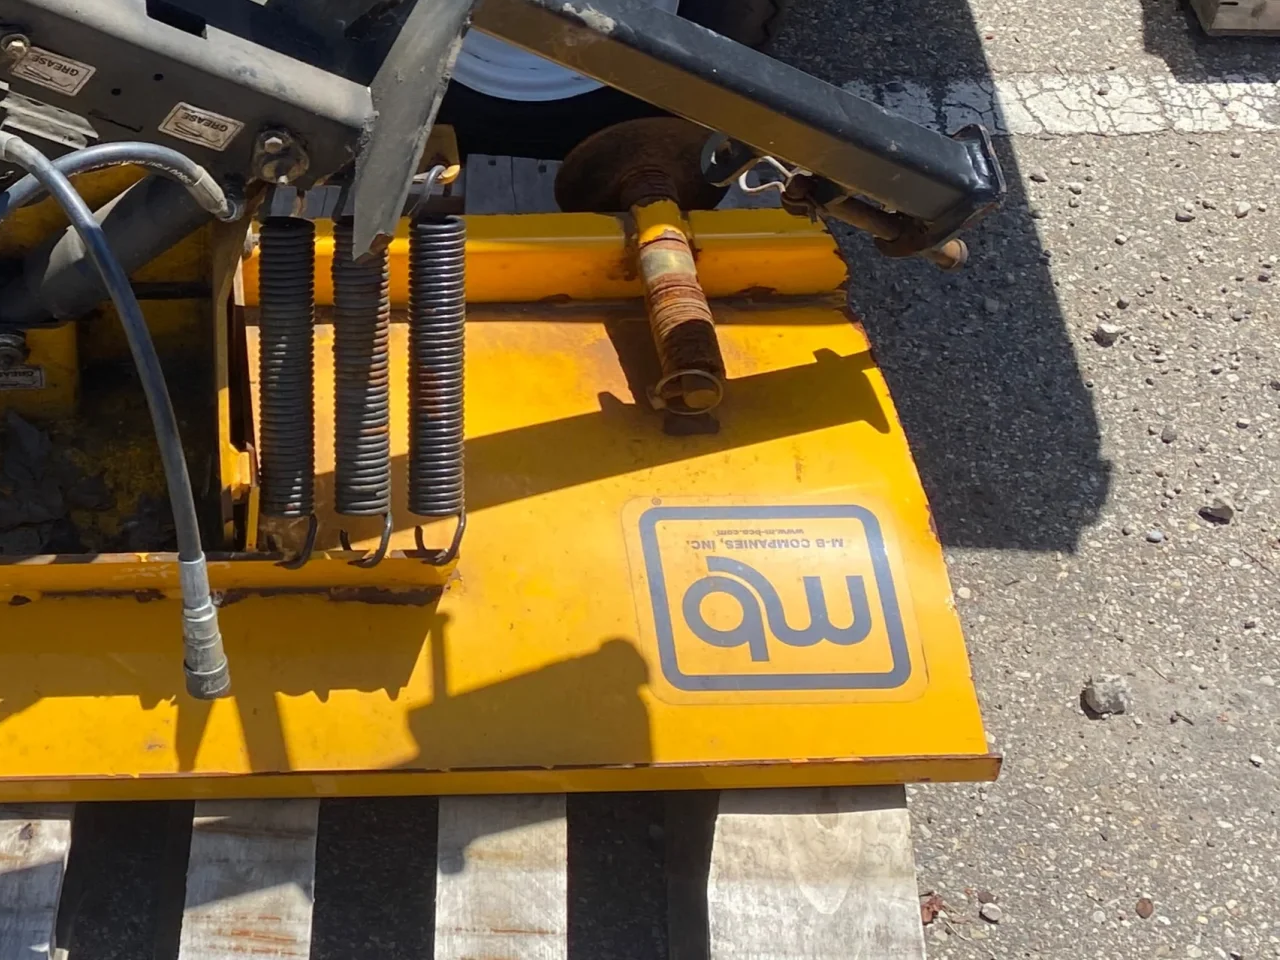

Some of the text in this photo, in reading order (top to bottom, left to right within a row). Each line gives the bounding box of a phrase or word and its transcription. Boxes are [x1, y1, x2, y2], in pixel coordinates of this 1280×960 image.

[29, 55, 80, 77] GREASE
[181, 112, 229, 133] GREASE
[719, 538, 810, 550] COMPANIES,
[815, 537, 844, 549] M-B
[682, 555, 872, 662] mb
